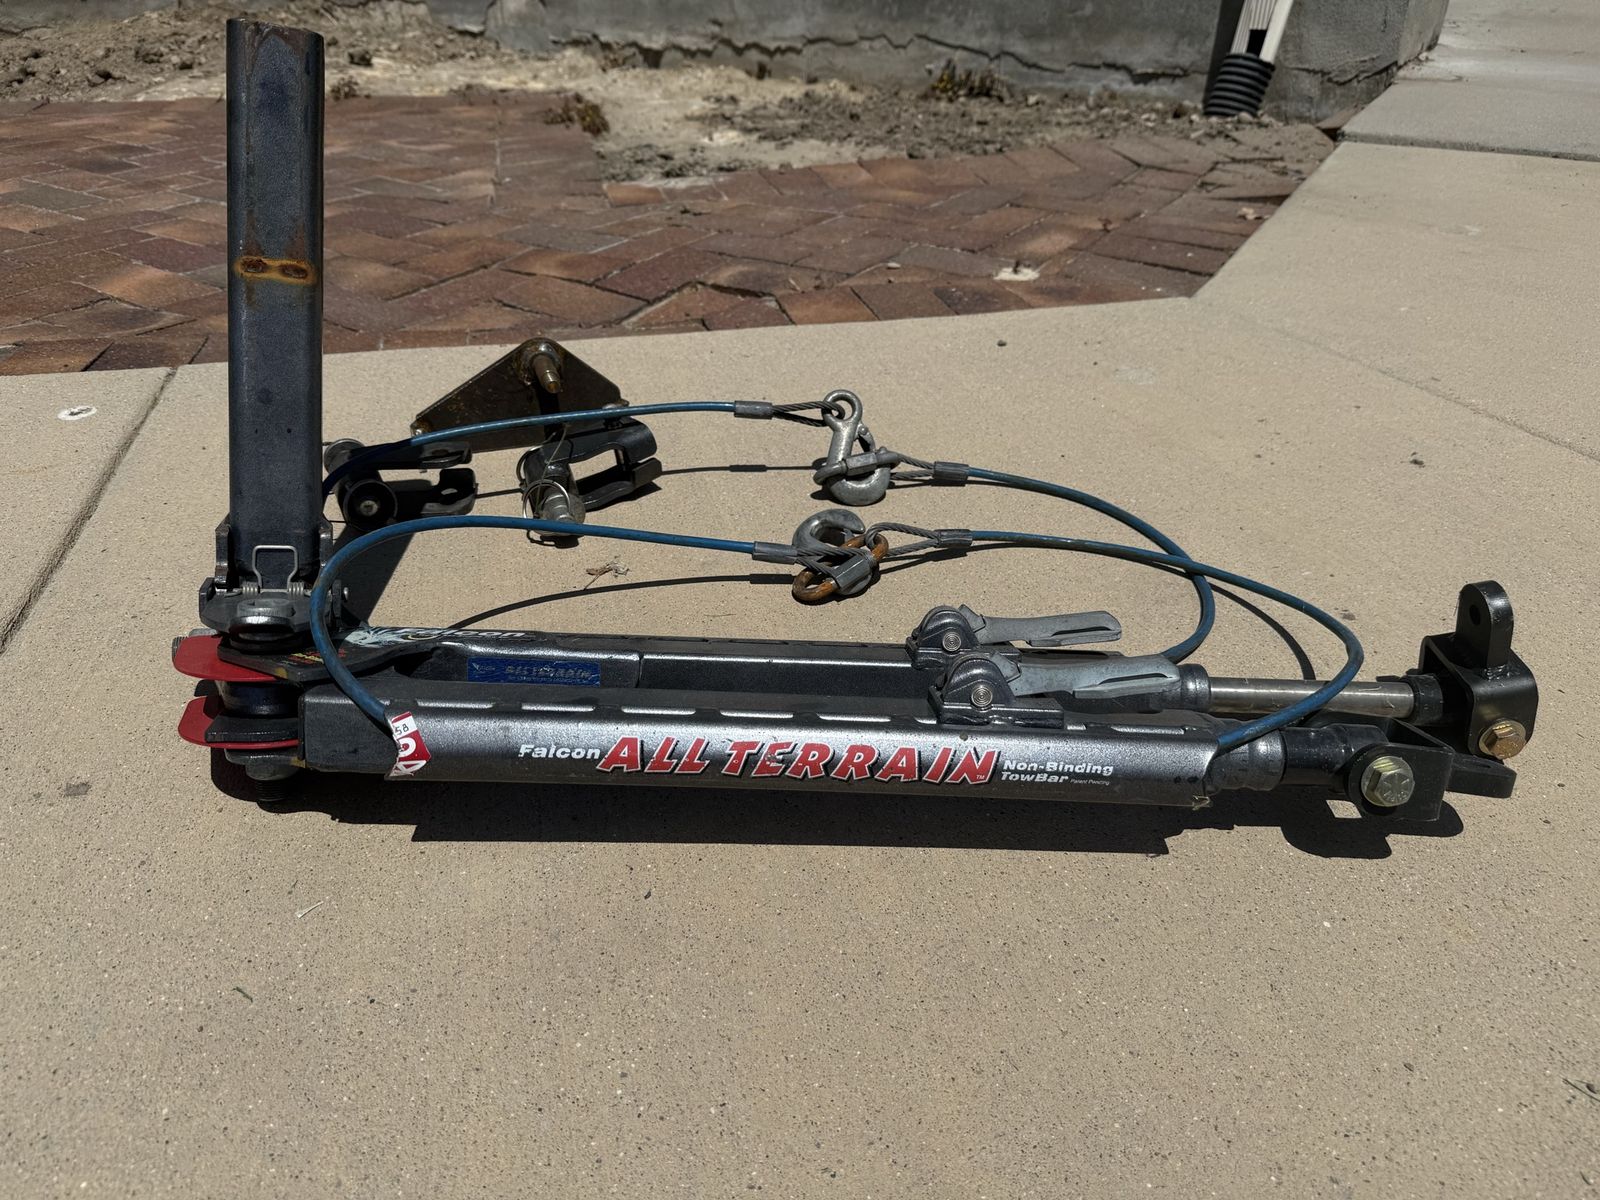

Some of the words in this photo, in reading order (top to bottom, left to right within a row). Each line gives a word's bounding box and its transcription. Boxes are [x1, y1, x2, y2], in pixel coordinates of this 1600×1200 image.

[518, 743, 601, 760] Falcon
[596, 736, 710, 774] ALL
[721, 740, 1000, 786] TERRAIN
[1003, 759, 1114, 777] Non-Binding
[1001, 771, 1069, 783] TowBar
